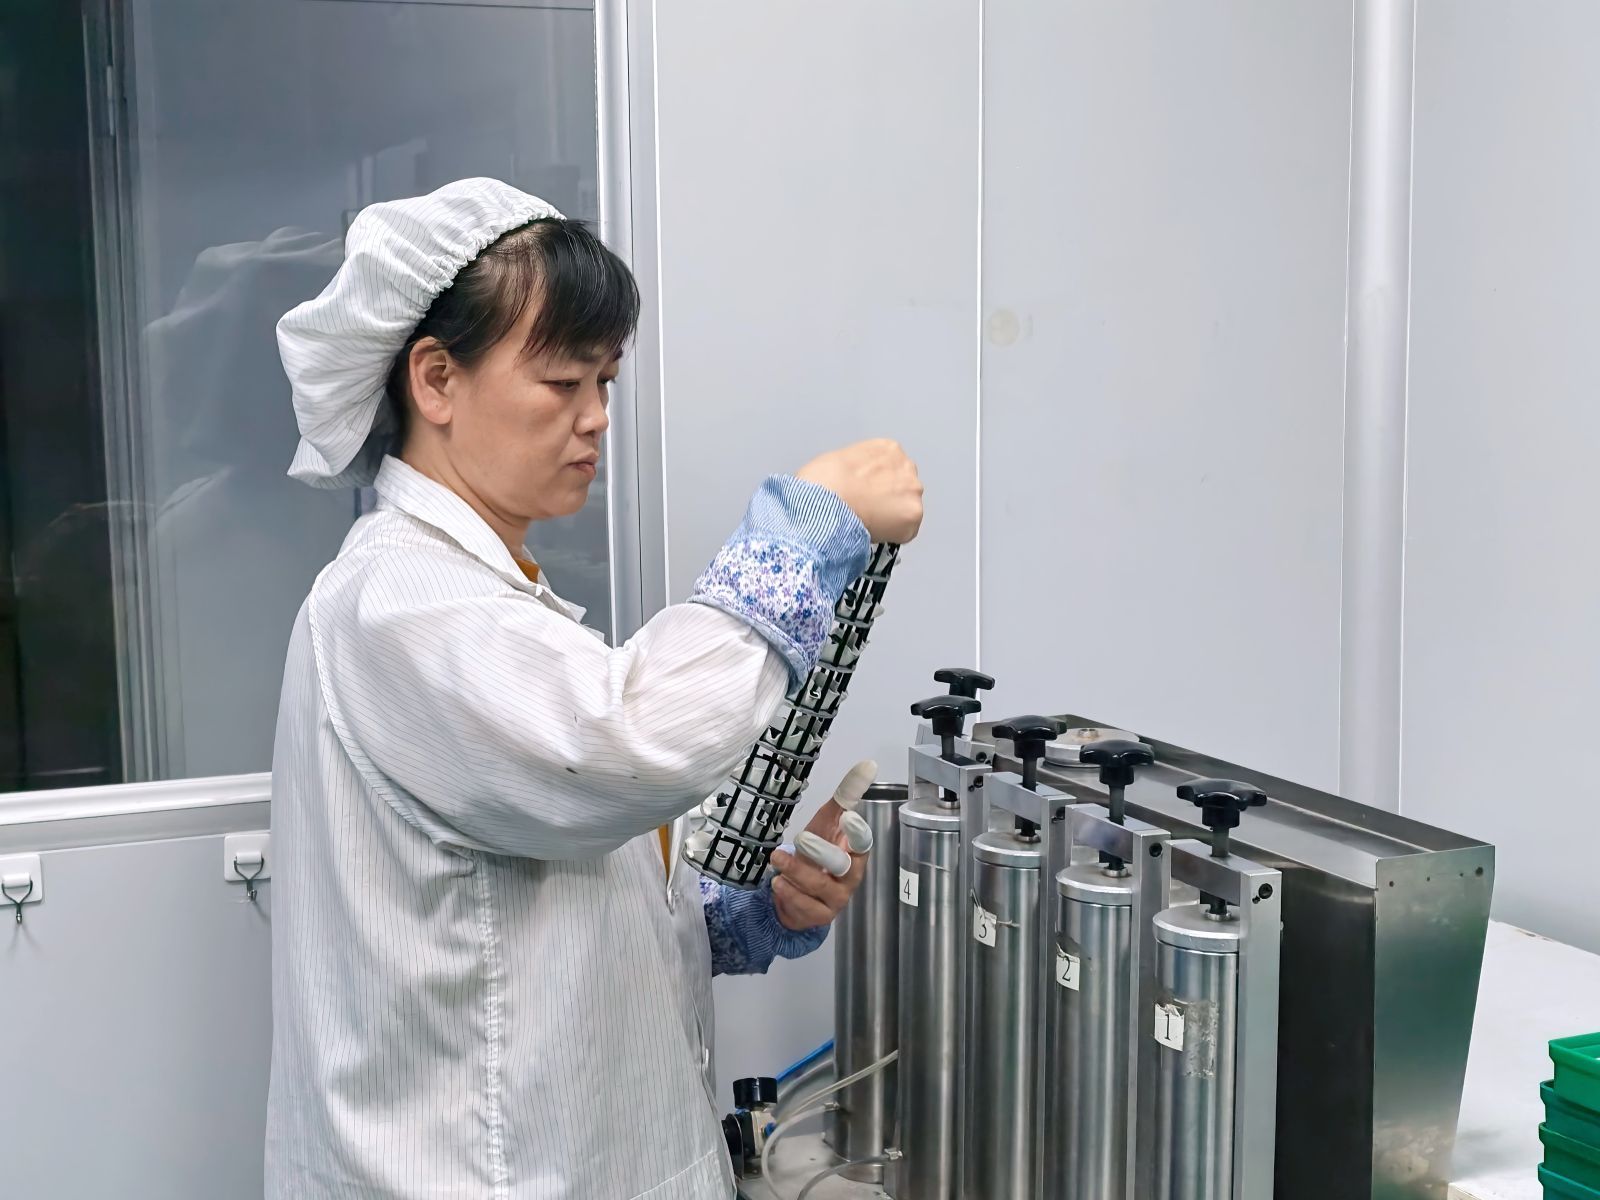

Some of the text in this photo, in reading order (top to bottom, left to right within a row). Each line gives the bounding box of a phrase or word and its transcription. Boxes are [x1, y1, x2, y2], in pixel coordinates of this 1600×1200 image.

[903, 878, 911, 900] 4
[978, 914, 987, 939] 3
[1061, 955, 1071, 982] 2
[1164, 1013, 1171, 1041] 1
